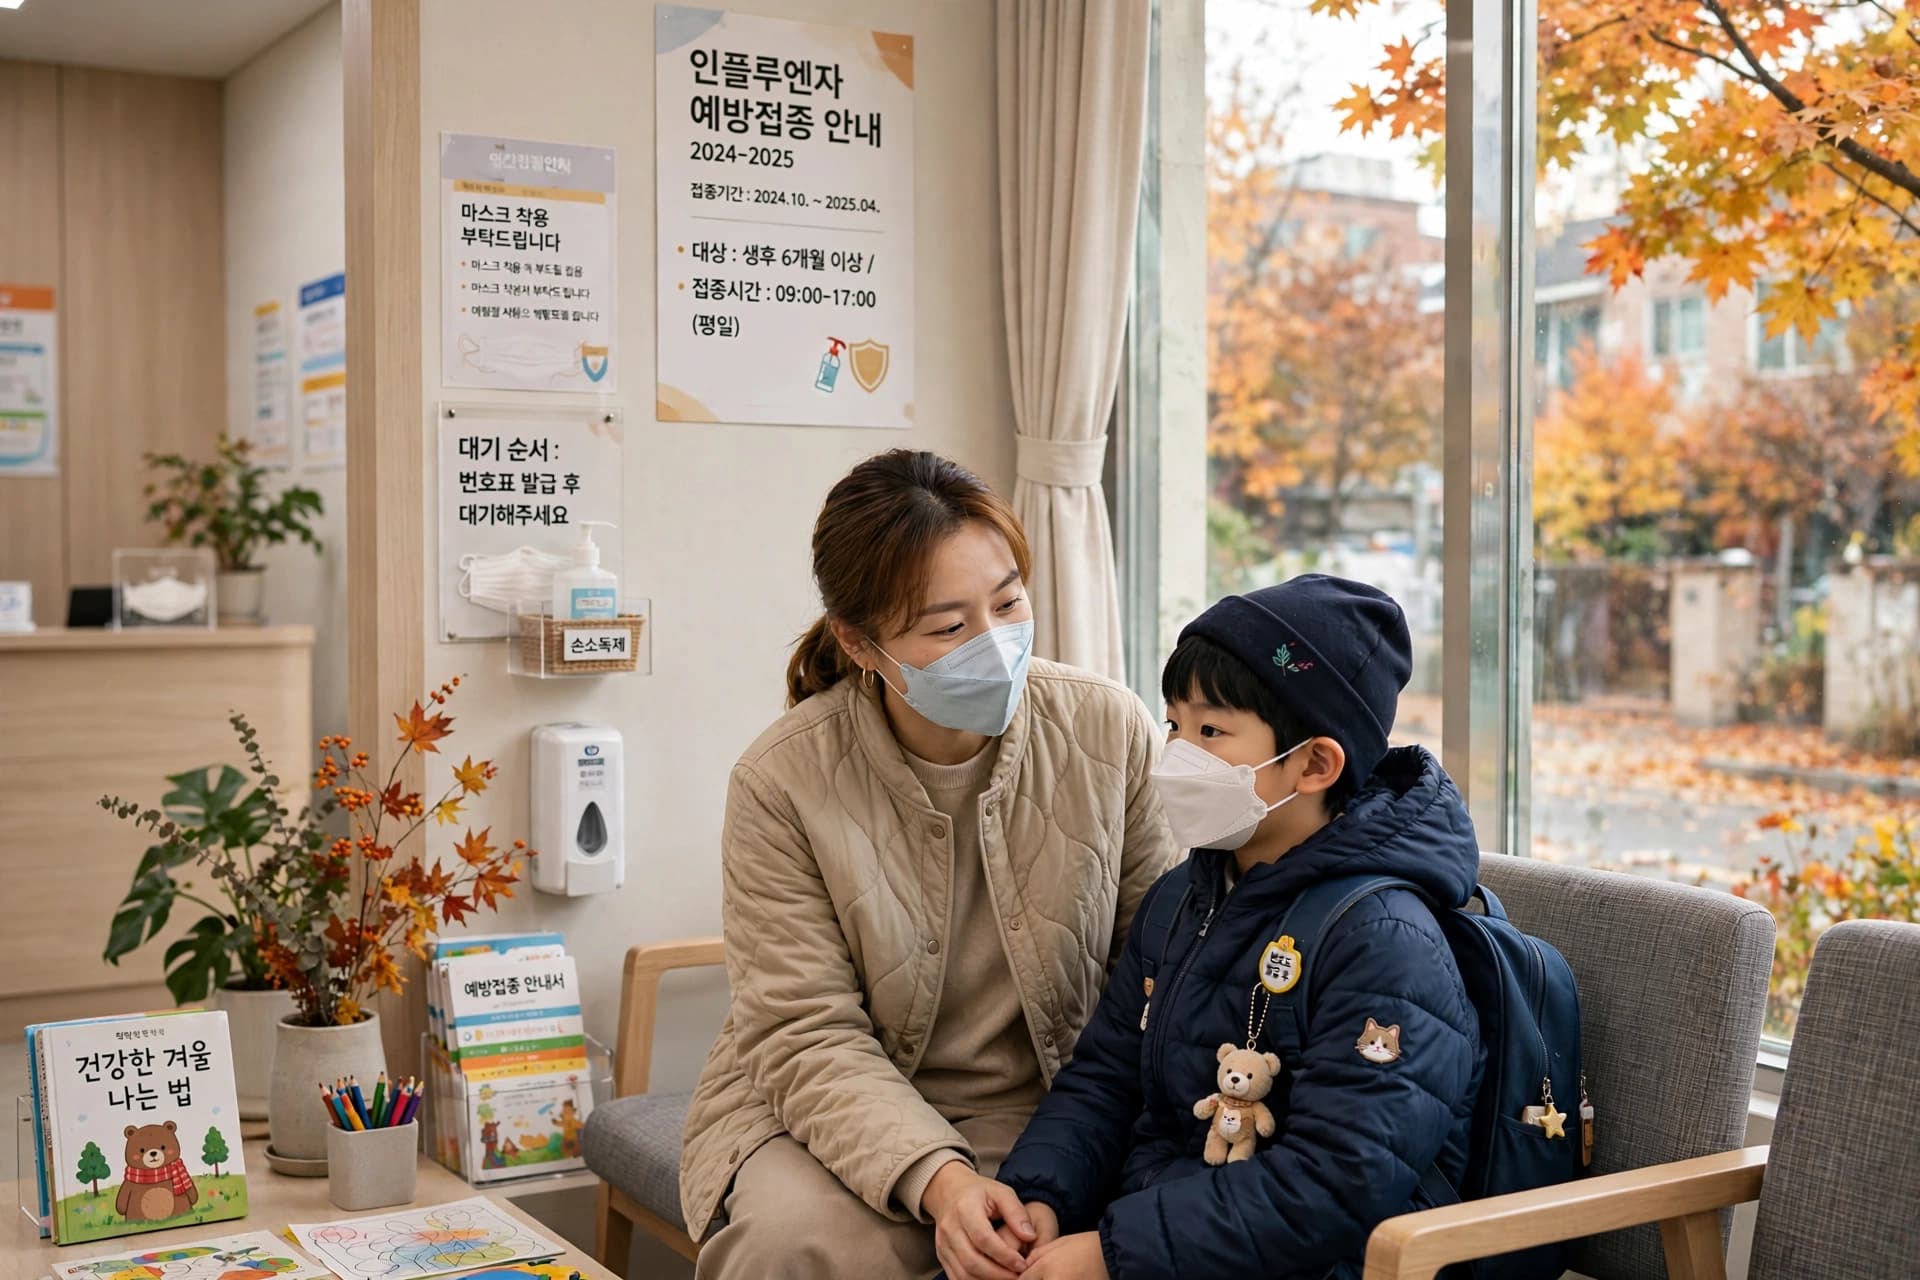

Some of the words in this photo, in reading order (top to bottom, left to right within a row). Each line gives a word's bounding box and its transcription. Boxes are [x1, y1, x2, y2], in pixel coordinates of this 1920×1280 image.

[689, 48, 844, 100] 인플루엔자
[690, 95, 814, 141] 예방접종
[824, 108, 881, 149] 안내
[689, 140, 795, 169] 2024-2025
[690, 182, 744, 203] 접종기간
[753, 188, 809, 208] 2024.10.
[825, 195, 881, 213] 2025.04.
[461, 202, 512, 224] 마스크
[515, 207, 549, 228] 착용
[460, 225, 561, 253] 부탁드립니다
[471, 260, 500, 271] 마스크
[692, 241, 728, 264] 대상
[742, 244, 777, 267] 생후
[781, 248, 825, 272] 6개월
[830, 251, 864, 274] 이상
[471, 282, 500, 294] 마스크
[692, 277, 762, 303] 접종시간
[775, 284, 877, 309] 09:00-17:00
[692, 313, 740, 338] (평일)
[458, 435, 500, 462] 대기
[507, 437, 548, 463] 순서
[459, 470, 516, 494] 번호표
[521, 471, 557, 495] 발급
[562, 472, 581, 496] 후
[459, 503, 569, 527] 대기해주세요
[570, 636, 626, 654] 손소독제
[464, 977, 520, 998] 예방접종
[523, 973, 565, 993] 안내서
[75, 1046, 156, 1084] 건강한
[162, 1039, 212, 1072] 겨울
[108, 1084, 159, 1112] 나는
[167, 1076, 192, 1108] 법
